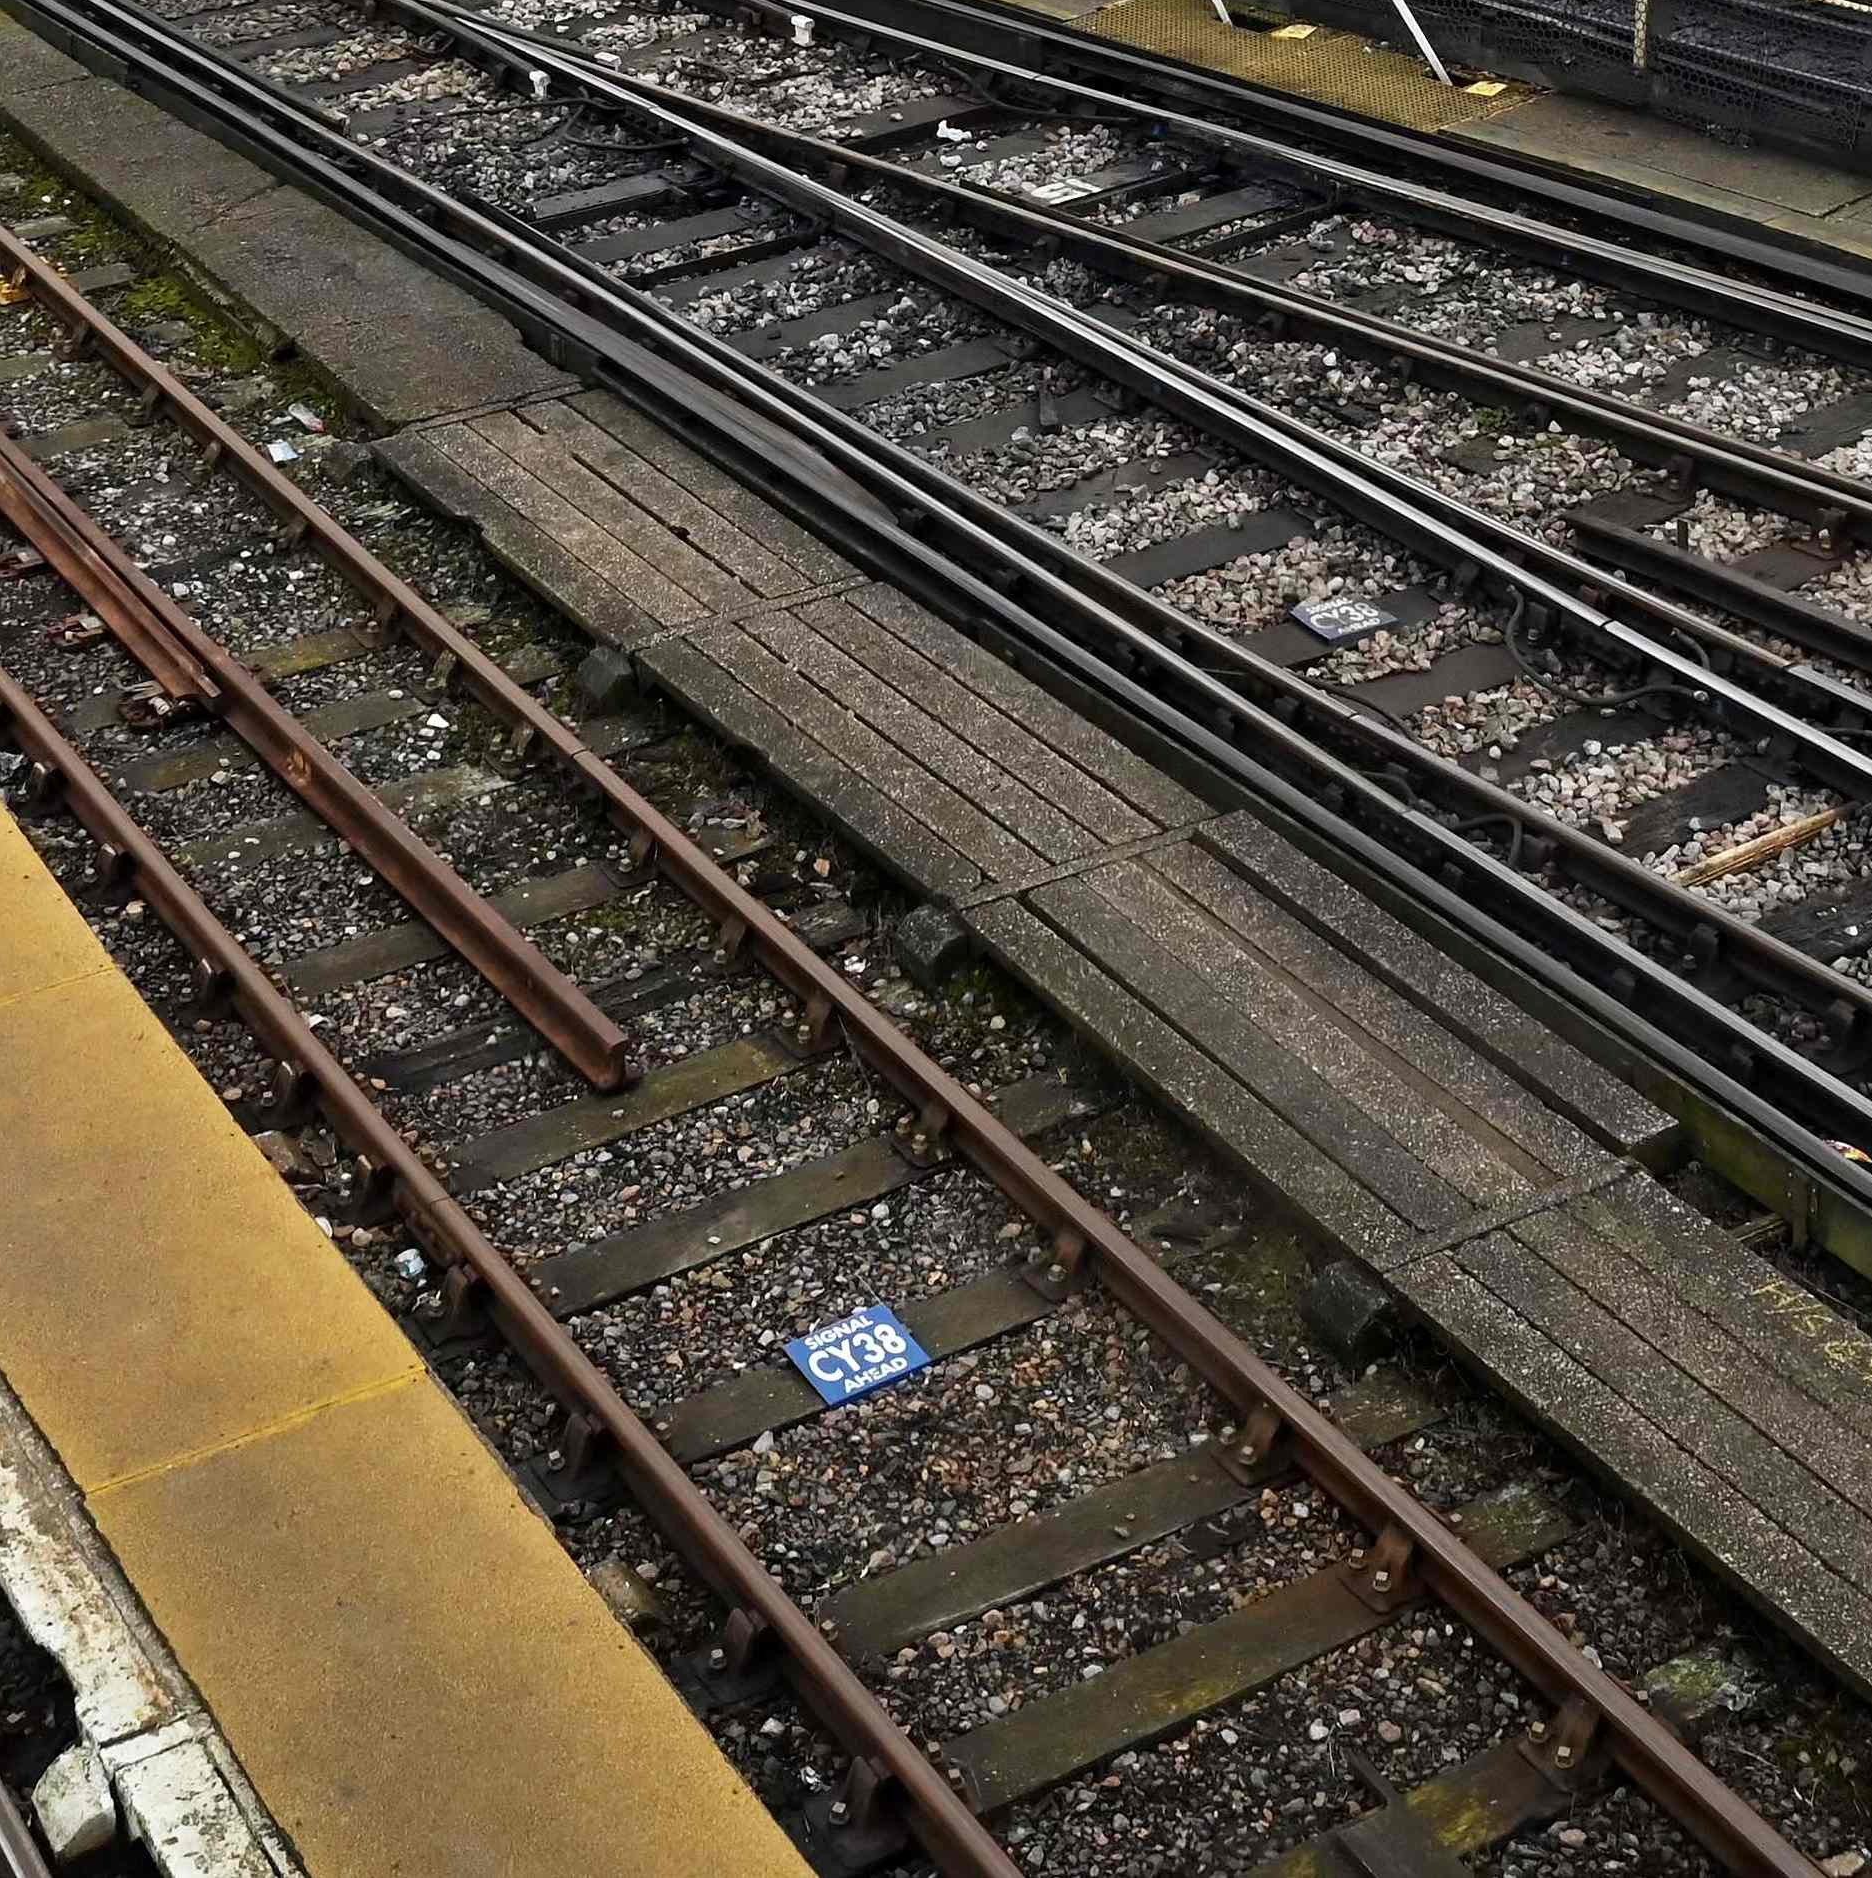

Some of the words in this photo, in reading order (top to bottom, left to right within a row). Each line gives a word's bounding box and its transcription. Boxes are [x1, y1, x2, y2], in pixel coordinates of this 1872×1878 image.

[1310, 602, 1379, 629] CY38
[804, 1314, 875, 1351] SIGNAL
[808, 1323, 908, 1382] CY38
[843, 1357, 909, 1394] AHEAD
